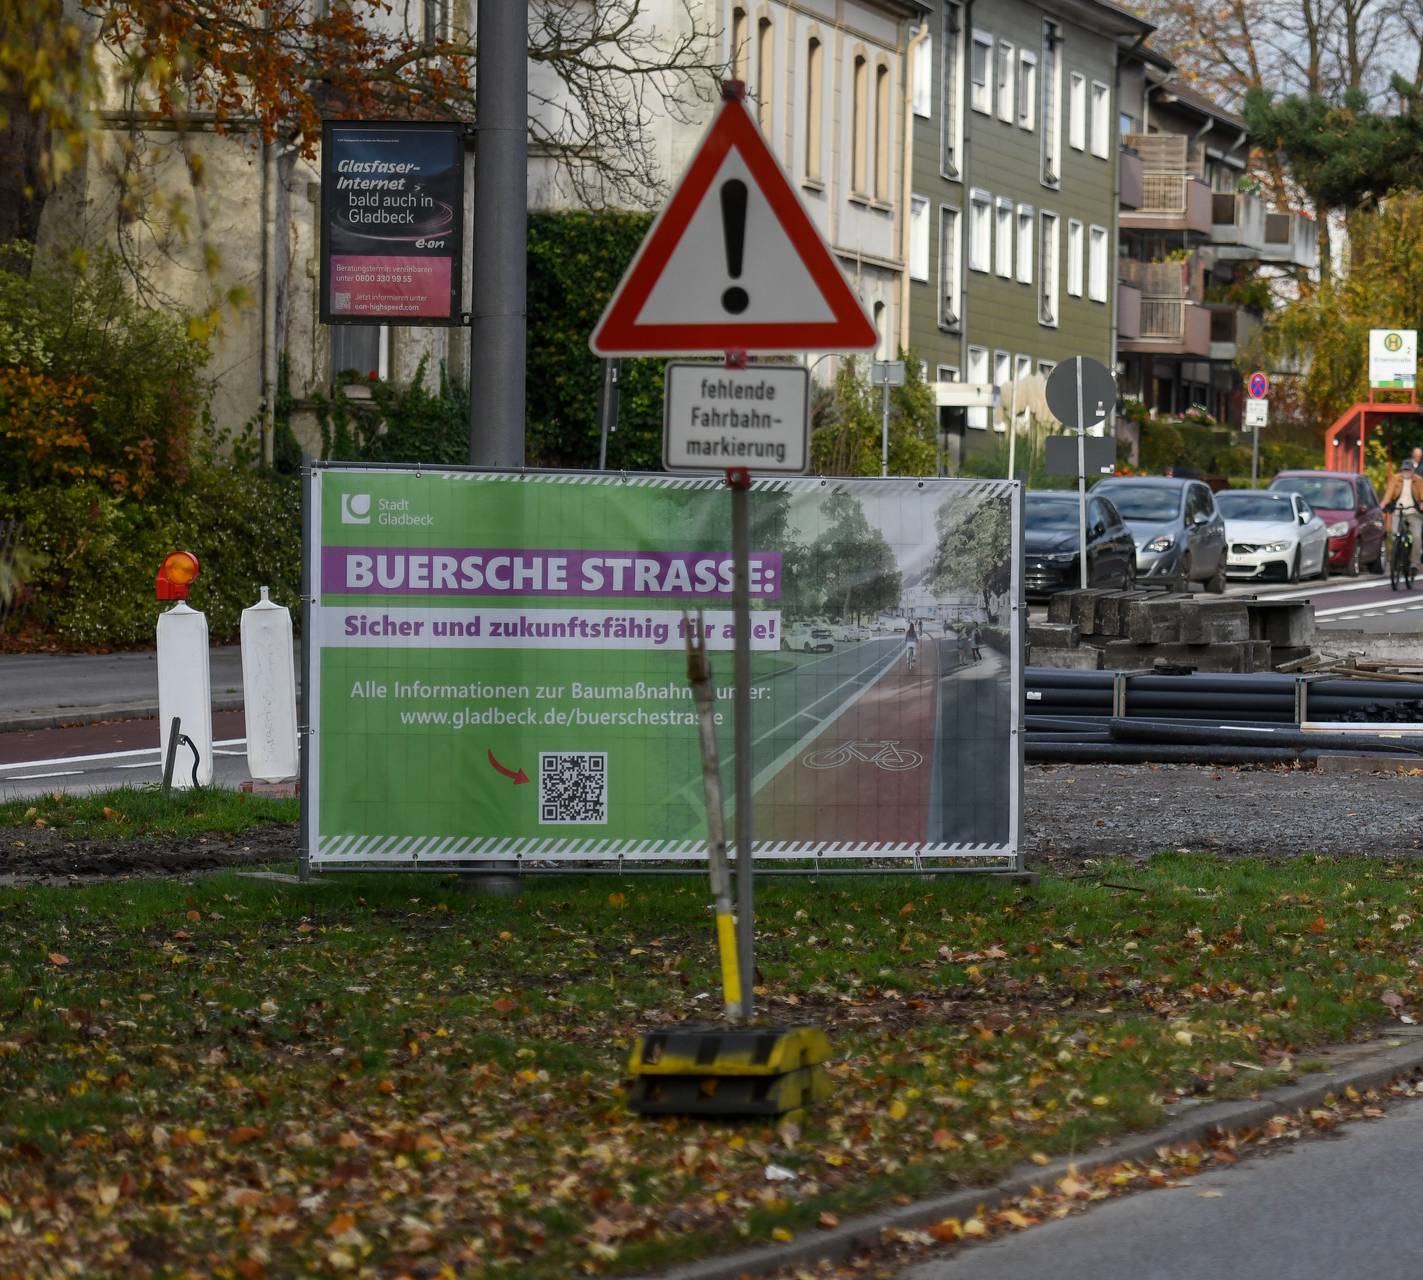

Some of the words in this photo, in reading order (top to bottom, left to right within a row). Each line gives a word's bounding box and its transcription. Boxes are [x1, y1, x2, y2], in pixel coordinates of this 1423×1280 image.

[337, 159, 421, 174] Glasfaser-
[336, 176, 406, 190] Internet
[349, 191, 379, 206] bald
[383, 193, 417, 207] auch
[421, 193, 433, 207] in
[348, 208, 414, 224] Gladbeck
[702, 379, 775, 400] fehlende
[691, 406, 782, 429] Fahrbahn-
[686, 436, 785, 463] markierung
[378, 498, 410, 512] Stadt
[378, 513, 434, 527] Gladbeck
[346, 554, 568, 591] BUERSCHE
[581, 557, 775, 593] STRASSE:
[344, 615, 424, 637] Sicher
[432, 616, 481, 637] und
[489, 616, 669, 644] zukunftsfähig
[351, 681, 387, 698] Alle
[394, 681, 529, 699] Informationen
[535, 686, 564, 698] zur
